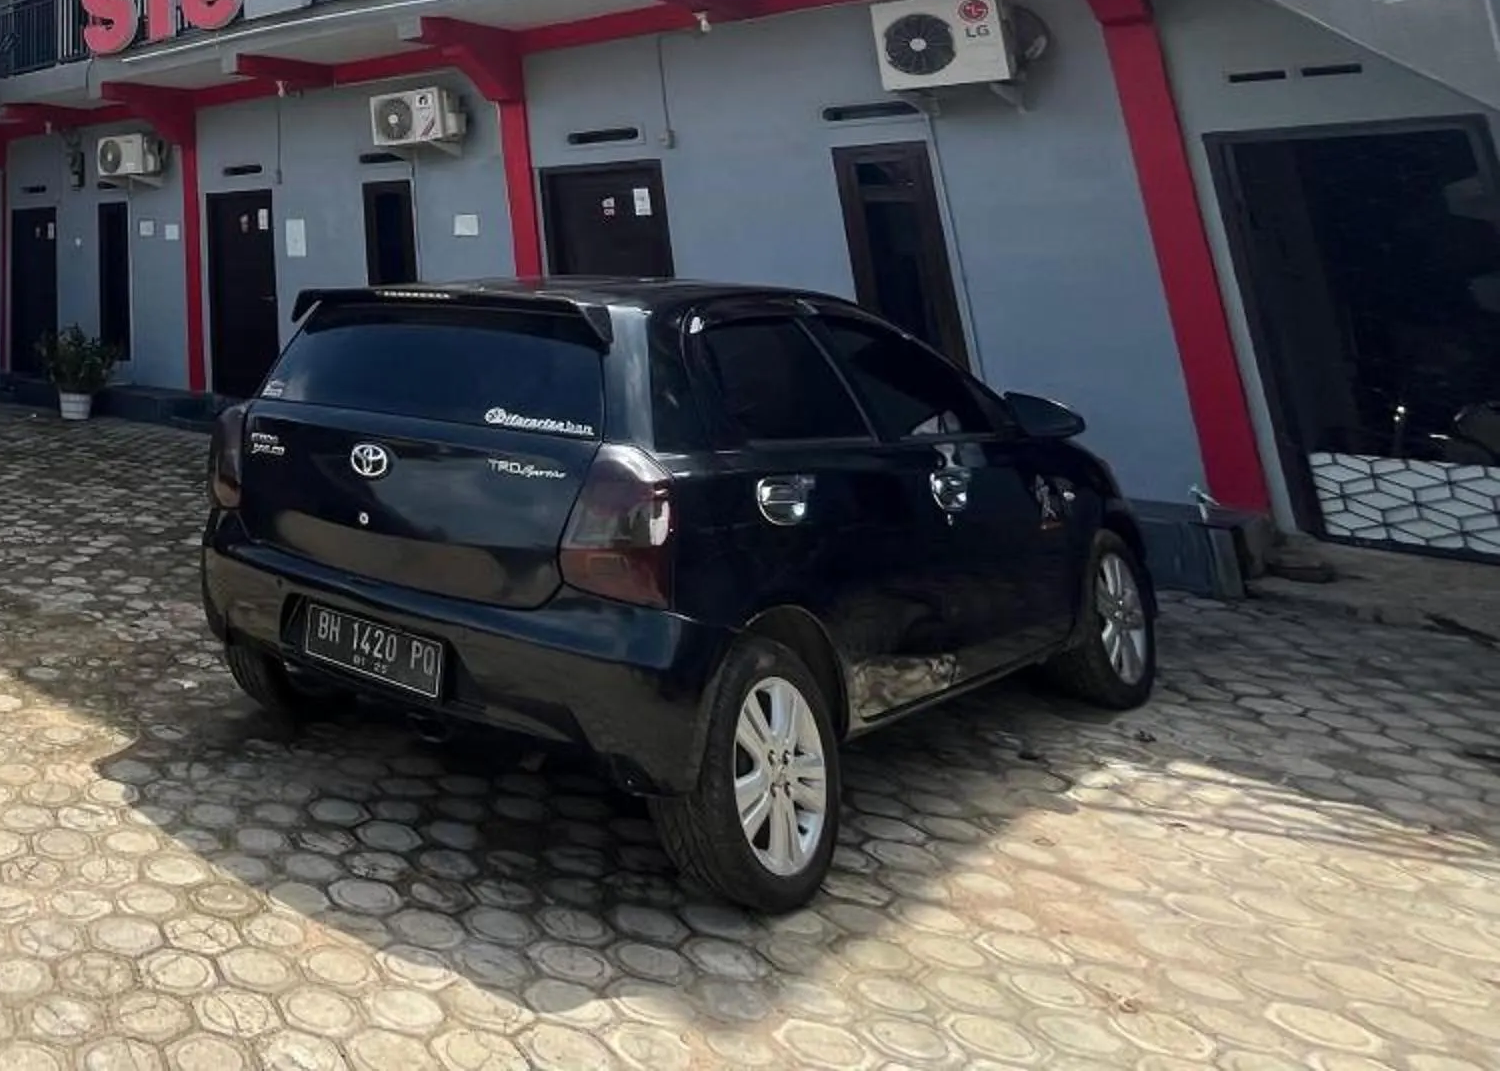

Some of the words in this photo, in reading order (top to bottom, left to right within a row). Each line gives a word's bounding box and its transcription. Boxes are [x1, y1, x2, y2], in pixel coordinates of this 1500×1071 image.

[966, 25, 990, 38] LG
[317, 611, 342, 644] BH
[352, 622, 398, 662] 1420
